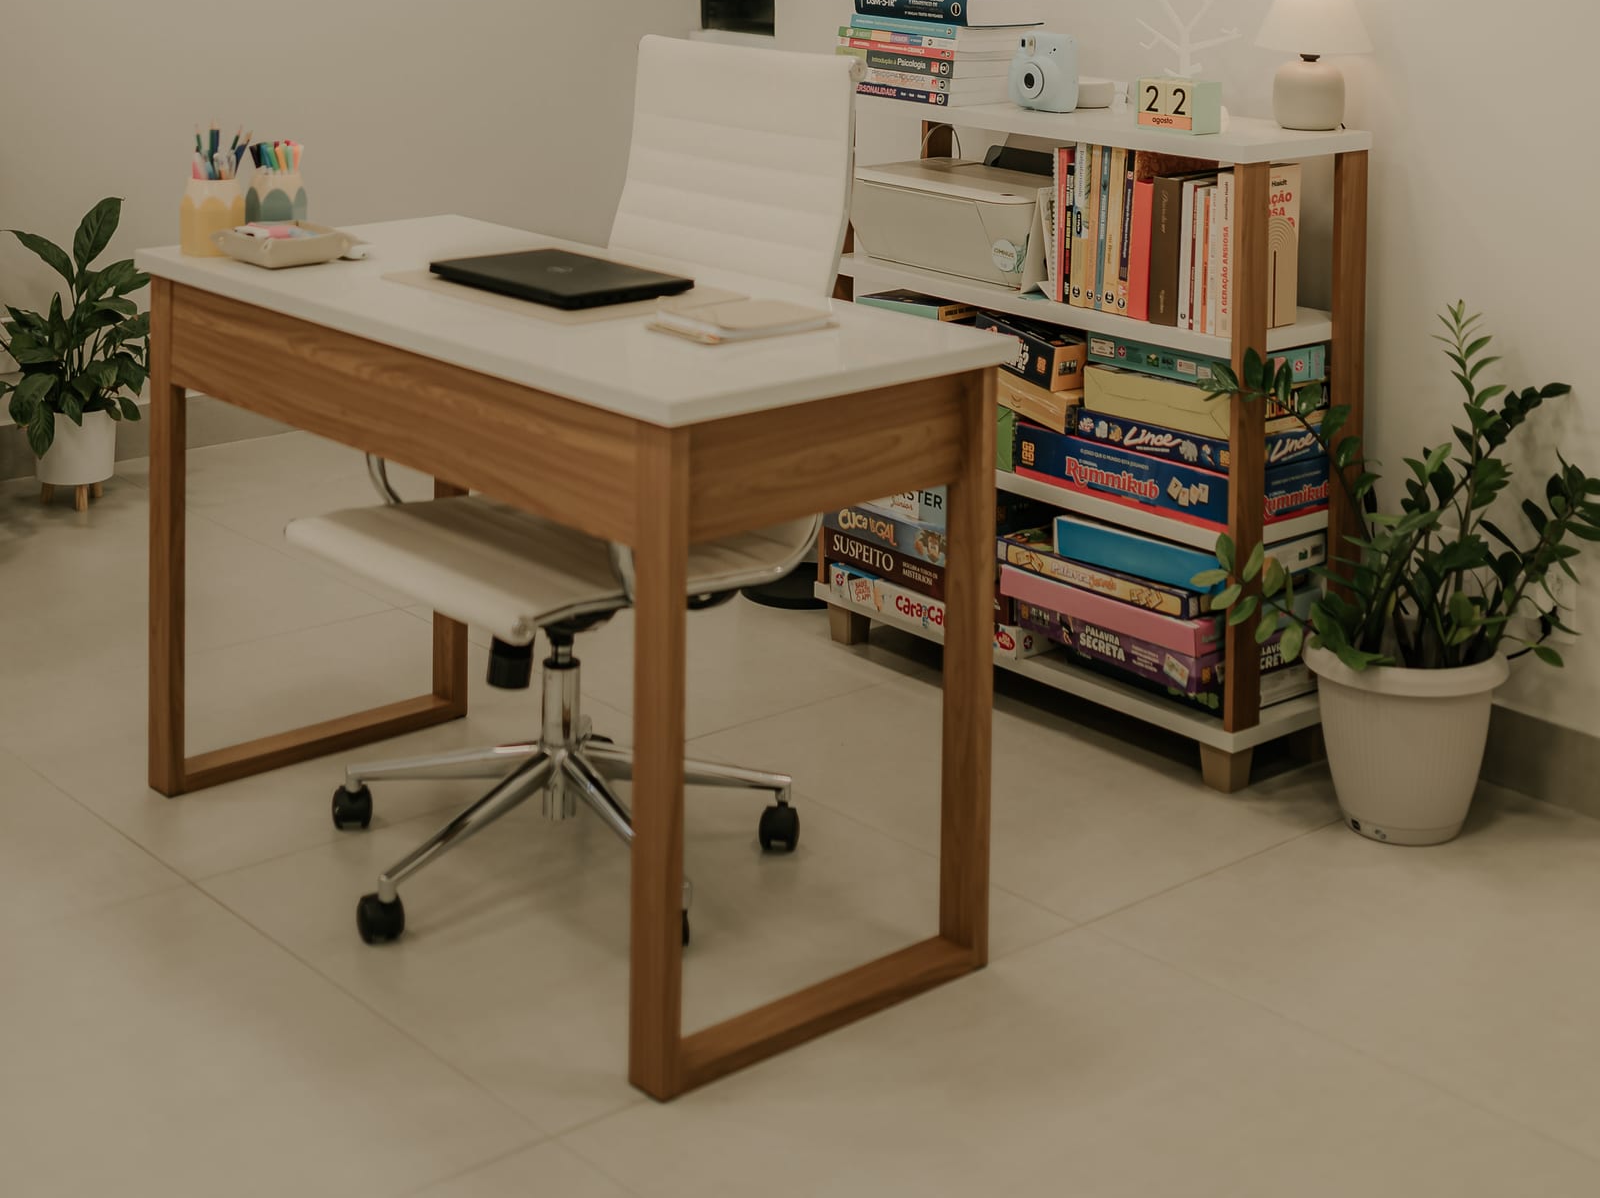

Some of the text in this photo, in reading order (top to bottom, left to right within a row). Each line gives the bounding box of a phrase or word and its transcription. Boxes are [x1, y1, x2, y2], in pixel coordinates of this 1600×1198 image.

[897, 58, 926, 70] Psicologia
[856, 84, 897, 97] ERSONALIDADE
[1152, 117, 1173, 125] agosto
[1272, 179, 1288, 187] Haidt
[1221, 226, 1229, 263] ANSIOSA
[1220, 267, 1229, 306] GERAÇÃO
[1065, 456, 1160, 499] Rummikub
[832, 534, 894, 572] SUSPEITO
[1079, 632, 1126, 662] SECRETA
[1085, 625, 1120, 646] PALAVRA
